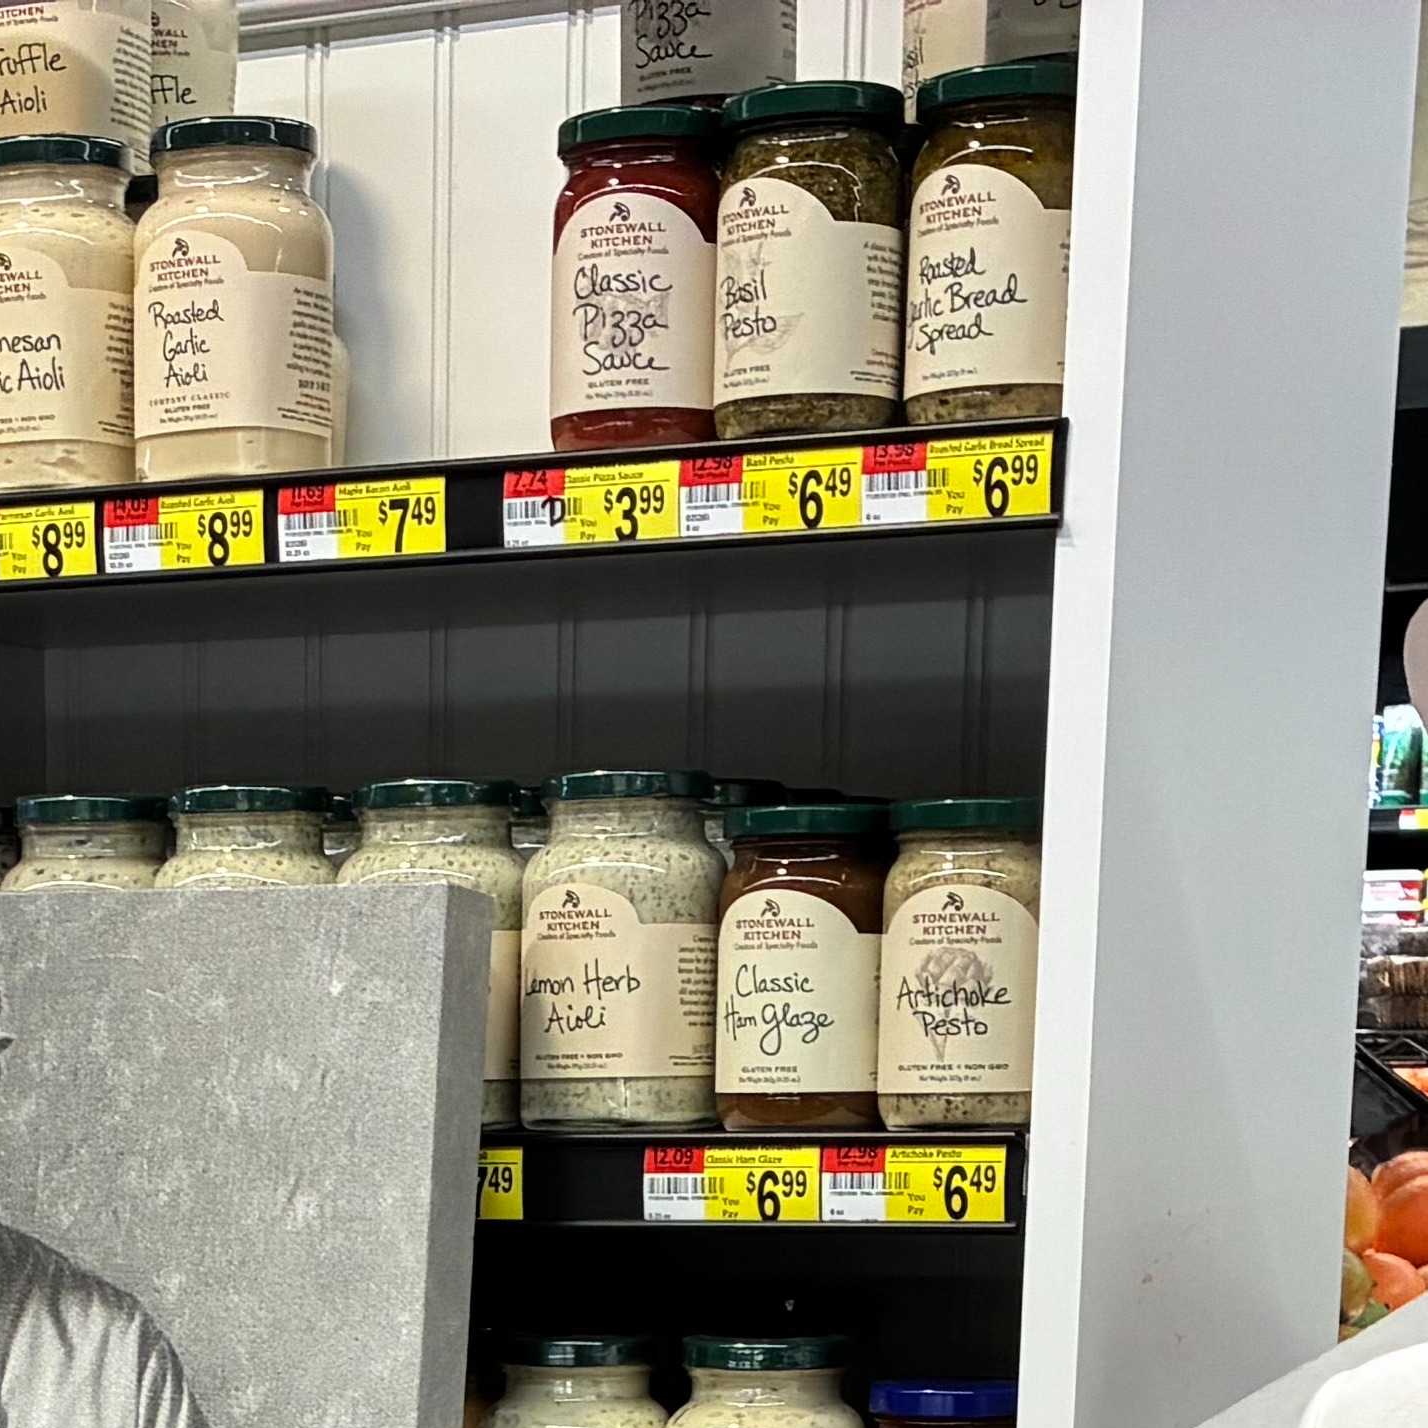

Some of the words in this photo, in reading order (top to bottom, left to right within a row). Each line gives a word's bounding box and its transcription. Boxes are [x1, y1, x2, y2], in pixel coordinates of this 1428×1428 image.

[637, 36, 712, 70] Sauce
[0, 87, 48, 116] Aioli
[580, 221, 667, 238] STONEWALL
[590, 234, 653, 248] KITCHEN
[573, 264, 673, 299] Classic
[919, 246, 986, 285] Roasted
[723, 272, 768, 309] Basil
[944, 273, 1028, 313] Bread
[148, 299, 224, 329] Roasted
[723, 313, 777, 341] Pesto
[162, 328, 211, 361] Garlic
[916, 313, 994, 355] Spread
[17, 357, 66, 392] Aioli
[165, 362, 209, 388] Aioli
[582, 342, 670, 376] Sauce
[912, 913, 1000, 924] STONEWALL
[922, 924, 987, 936] KITCHEN
[524, 972, 575, 998] Lemon
[584, 958, 641, 994] Herb
[735, 965, 815, 996] Classic
[895, 979, 1013, 1012] Artichoke
[544, 1005, 607, 1035] Aioli
[724, 994, 757, 1036] Ham
[912, 1010, 989, 1038] Pesto
